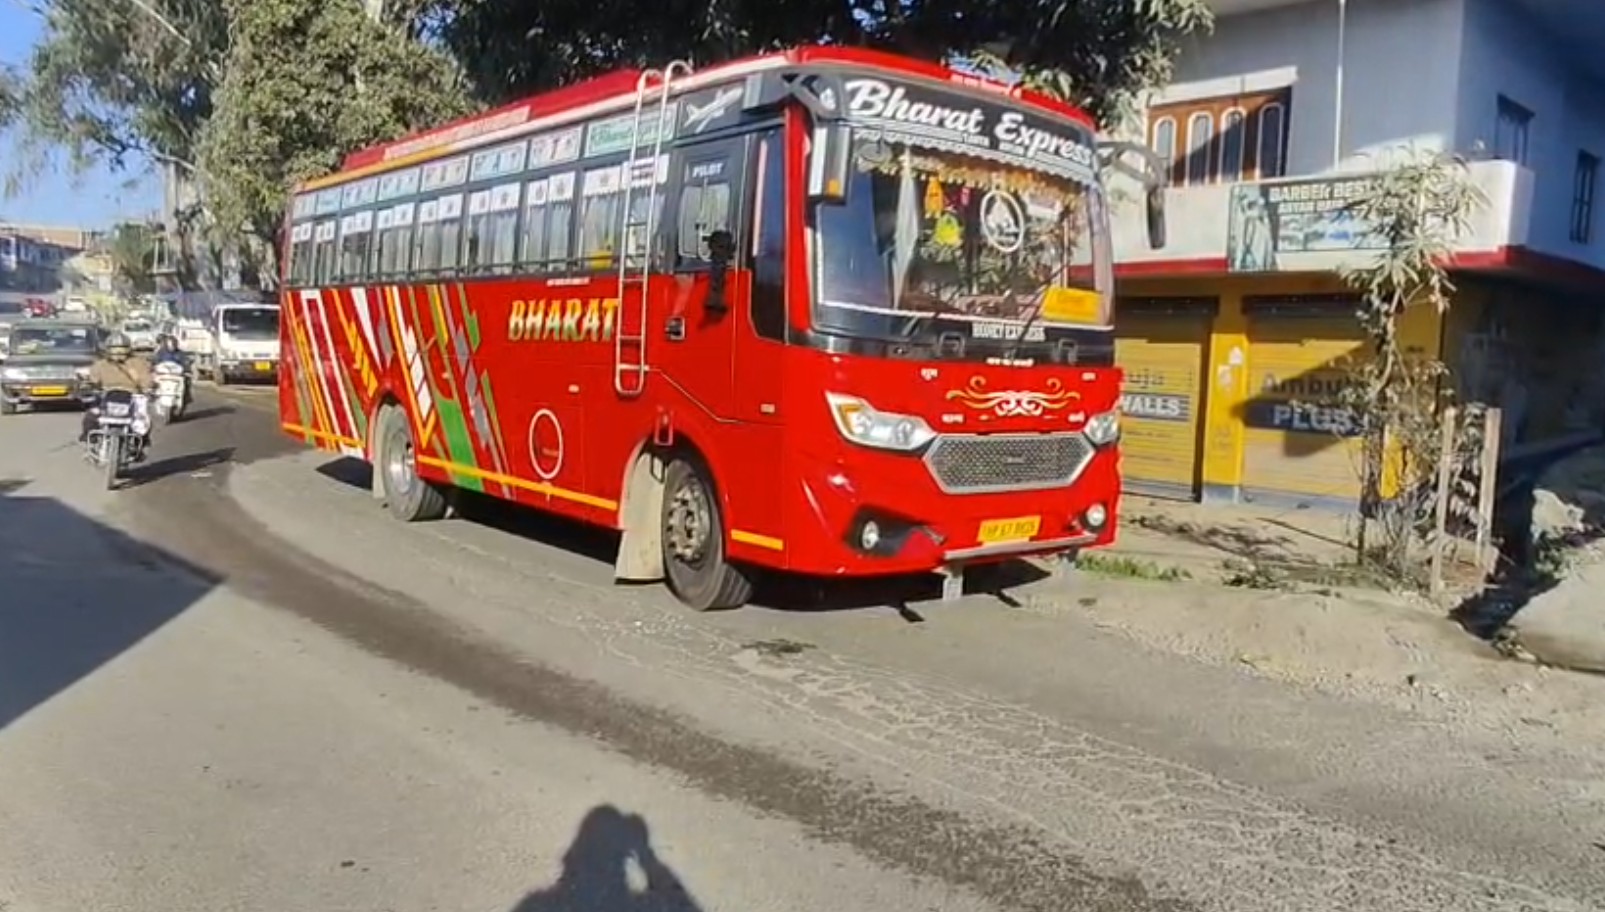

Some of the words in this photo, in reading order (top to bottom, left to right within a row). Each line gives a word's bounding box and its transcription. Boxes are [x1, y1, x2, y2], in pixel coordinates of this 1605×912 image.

[844, 79, 984, 133] Bharat
[994, 111, 1093, 166] Express
[692, 163, 723, 178] PILOT
[508, 298, 619, 341] BHARAT
[1127, 368, 1164, 389] uja
